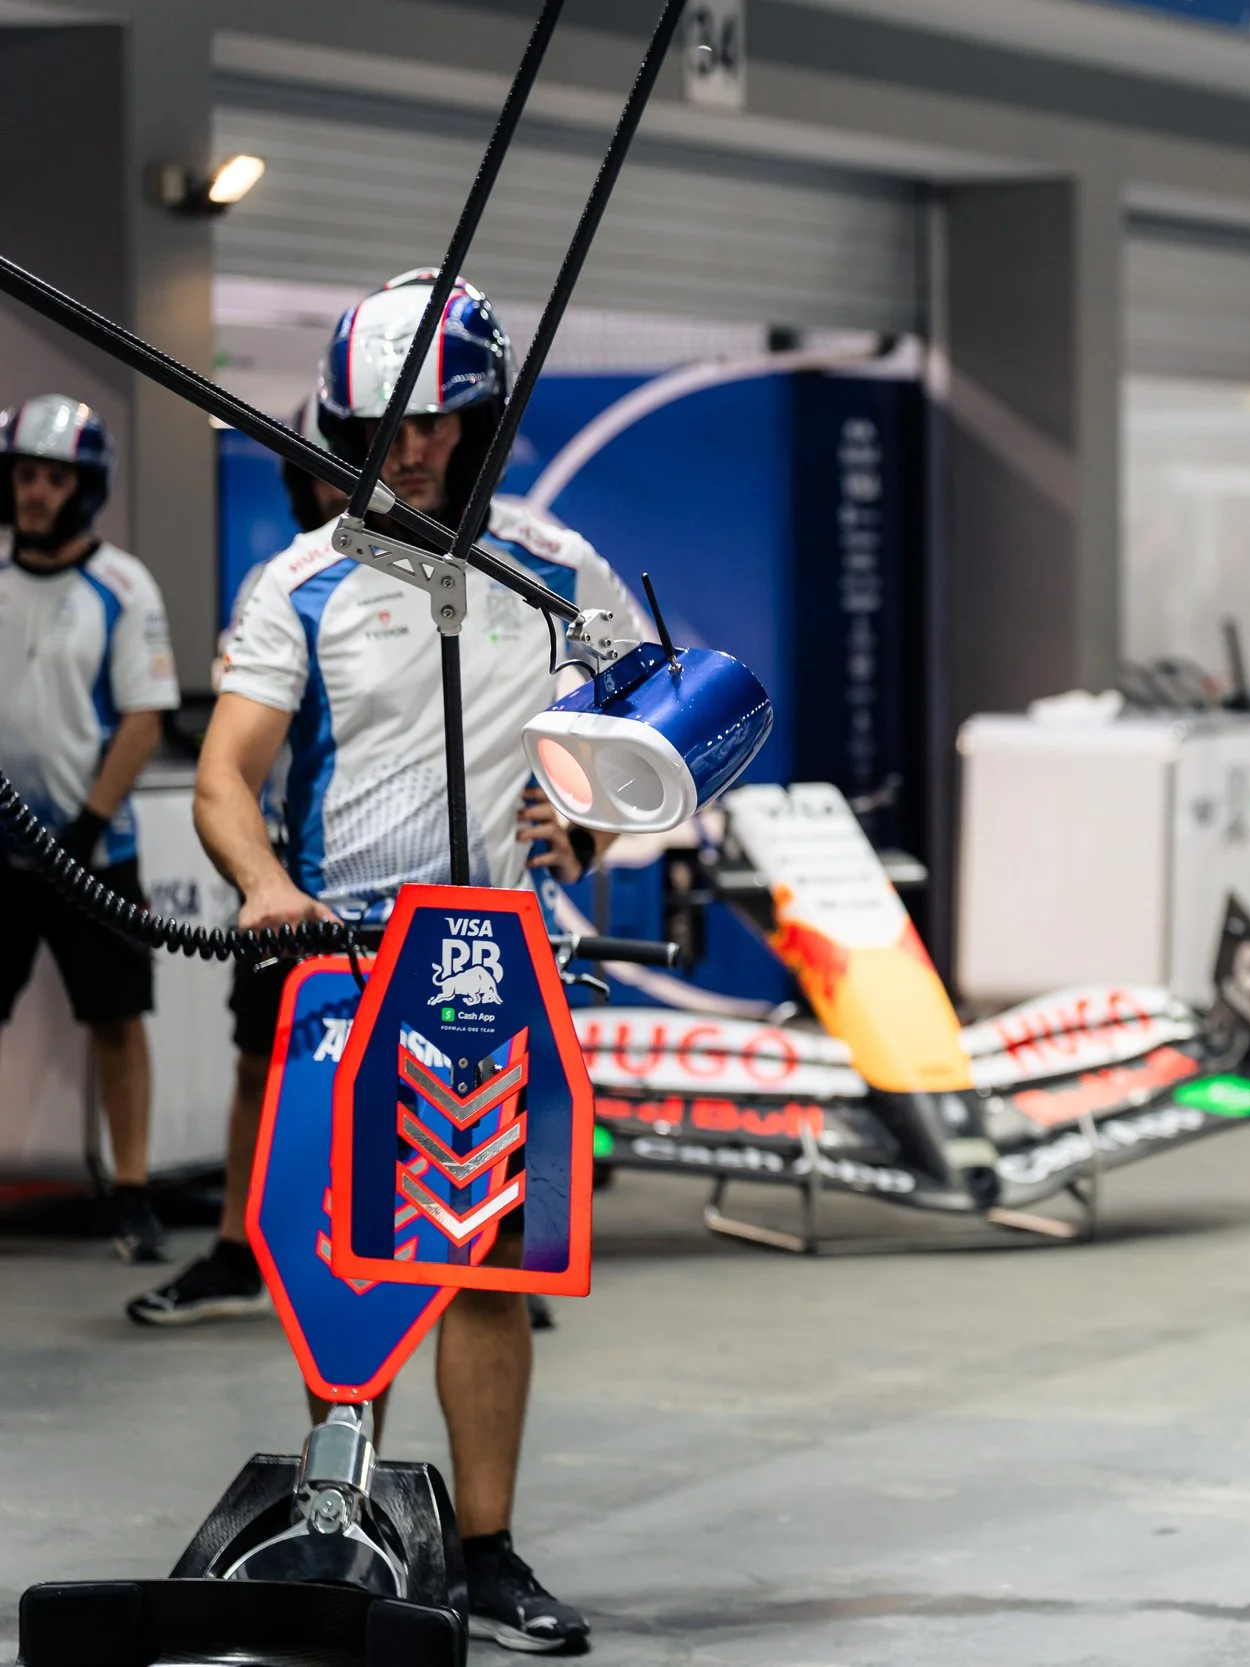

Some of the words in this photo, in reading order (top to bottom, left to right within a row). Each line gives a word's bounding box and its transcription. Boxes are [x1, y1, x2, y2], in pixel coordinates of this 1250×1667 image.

[444, 917, 493, 938] VISA
[457, 1011, 478, 1021] Cash
[478, 1012, 496, 1023] App
